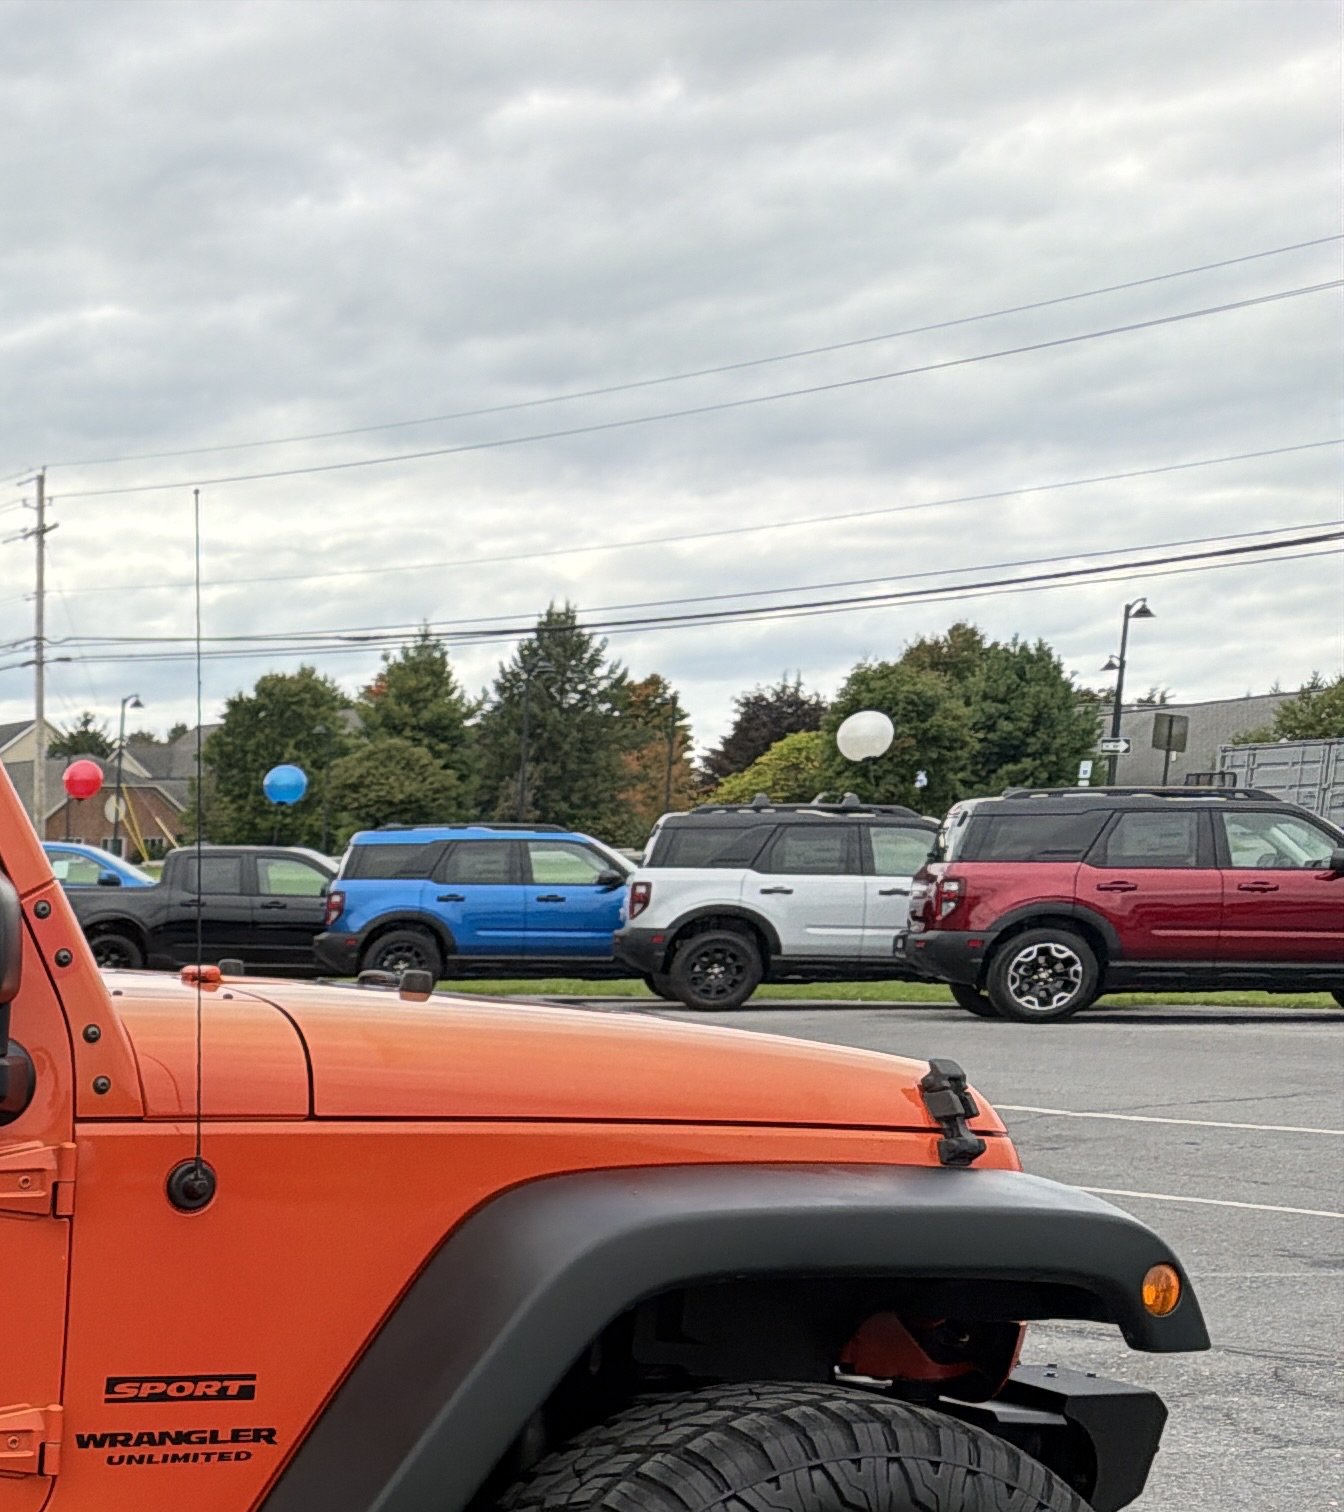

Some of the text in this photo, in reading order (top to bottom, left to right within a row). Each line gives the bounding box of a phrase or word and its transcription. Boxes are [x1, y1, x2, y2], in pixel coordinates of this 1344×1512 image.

[109, 1379, 256, 1399] SPORT
[75, 1427, 278, 1449] WRANGLER
[106, 1450, 253, 1466] UNLIMITED
